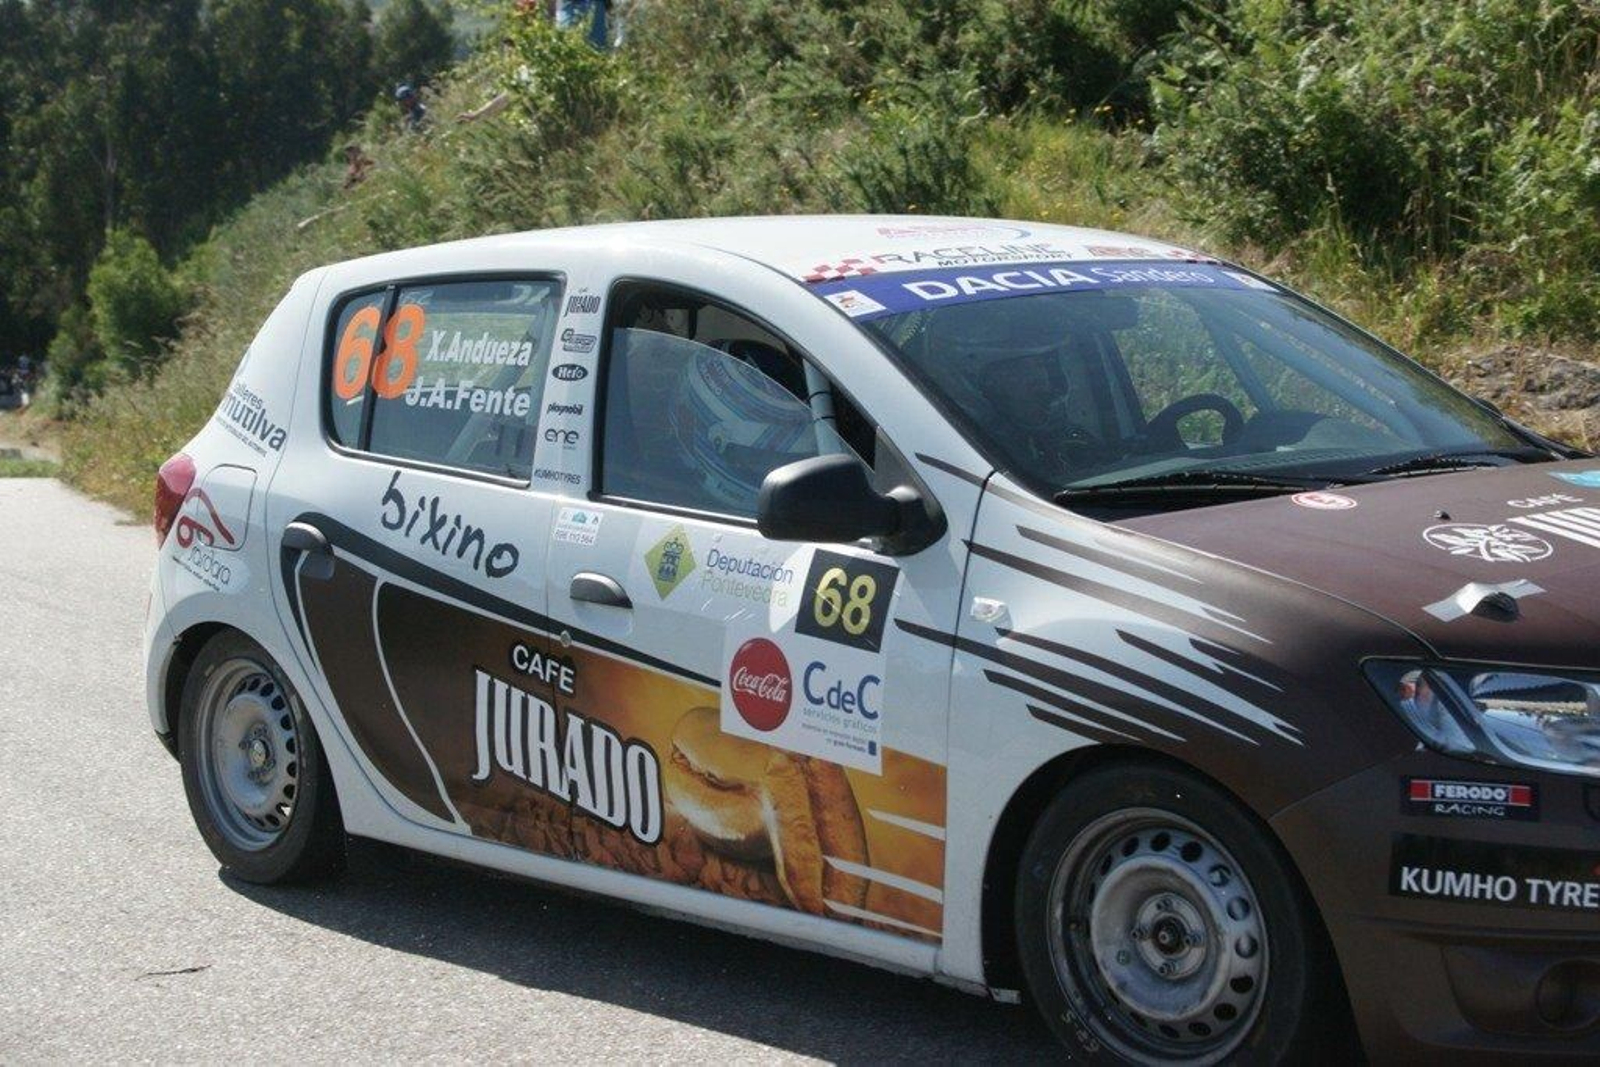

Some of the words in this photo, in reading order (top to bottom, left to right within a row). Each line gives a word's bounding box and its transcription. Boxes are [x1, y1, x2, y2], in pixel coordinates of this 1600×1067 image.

[870, 243, 1066, 264] RACELINE
[937, 252, 1073, 267] MOTORSPORT
[901, 267, 1100, 301] DACIA
[1090, 266, 1215, 284] Sandero
[333, 303, 426, 400] 68
[425, 329, 534, 367] X.Andueza
[381, 471, 520, 579] bixino
[707, 548, 794, 584] Deputación
[814, 566, 877, 635] 68
[512, 644, 575, 694] CAFE
[472, 668, 662, 845] JURADO
[1433, 783, 1508, 801] FERODO
[1434, 802, 1506, 817] RACING
[1400, 865, 1518, 902] KUMHO
